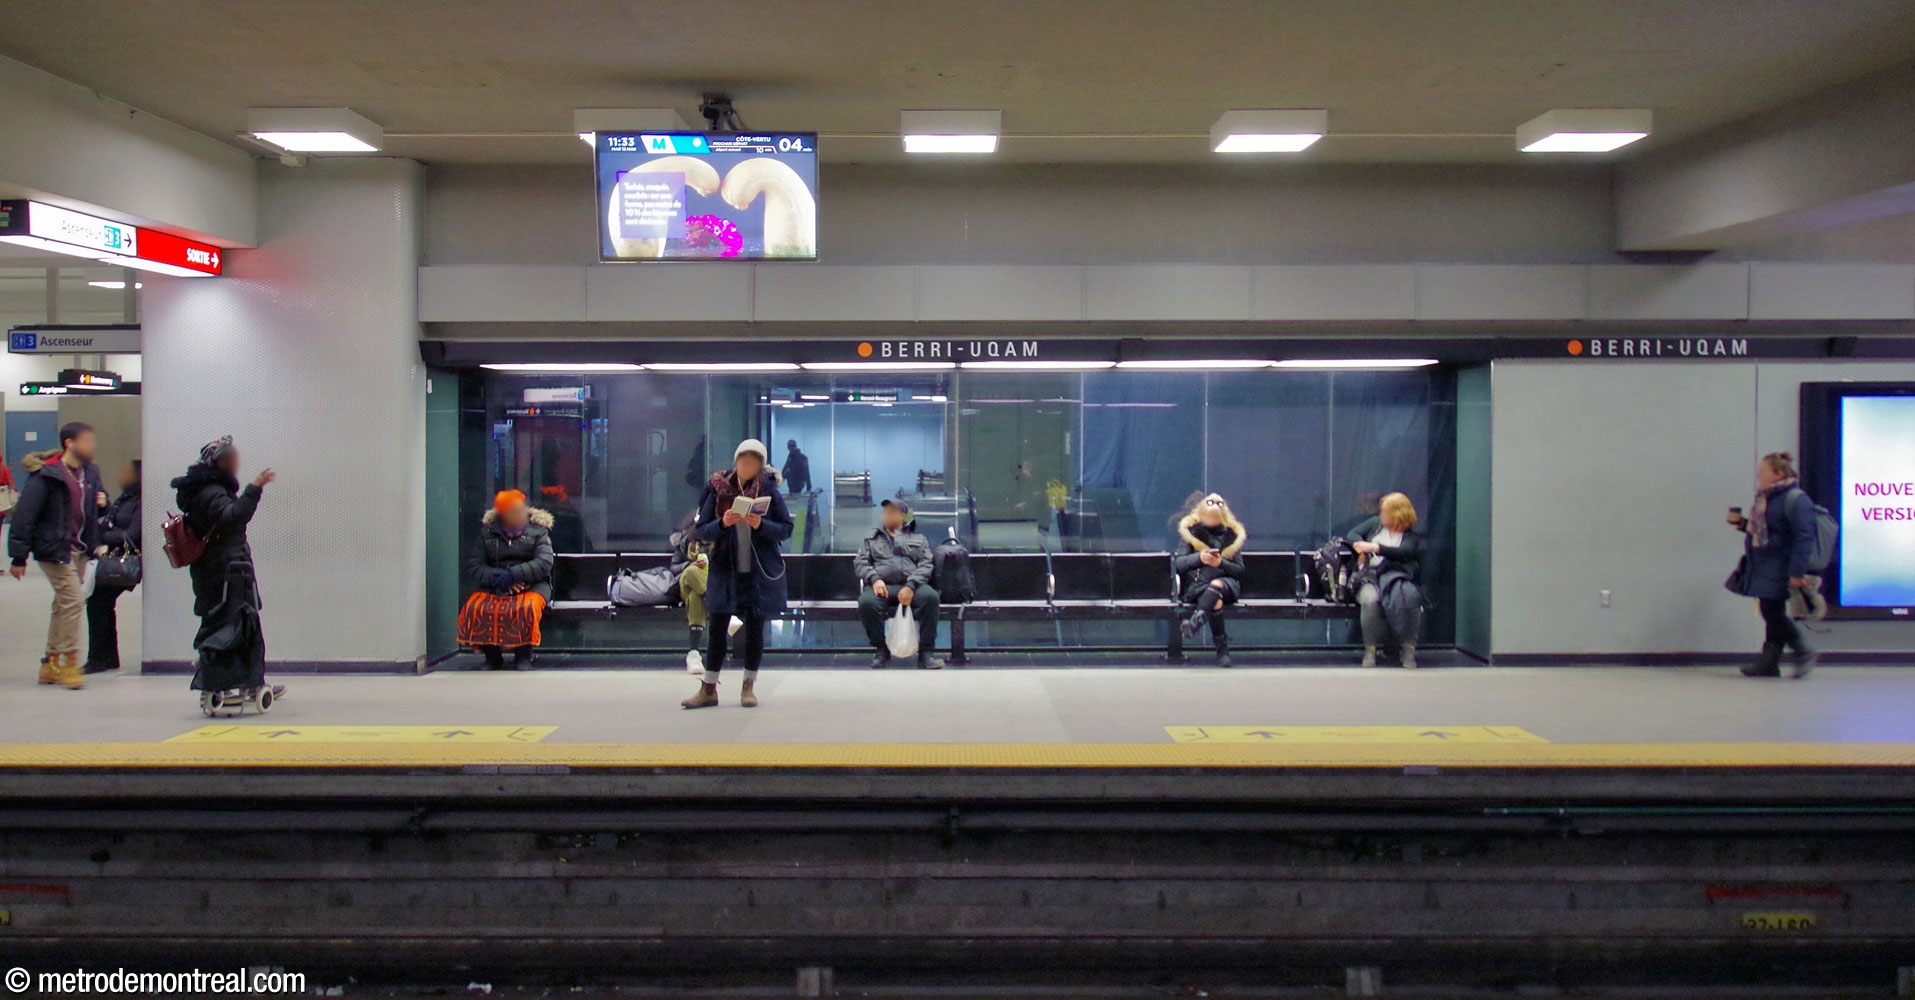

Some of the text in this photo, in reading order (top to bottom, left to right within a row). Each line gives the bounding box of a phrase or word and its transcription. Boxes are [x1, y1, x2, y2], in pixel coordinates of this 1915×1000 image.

[608, 137, 666, 150] 11:33 M
[735, 135, 772, 143] CÔTE-VERTU
[778, 137, 803, 152] 04
[186, 247, 211, 266] SORTIE
[27, 335, 94, 347] 3 Ascenseur
[1590, 339, 1749, 356] BERRI-UQAM
[881, 341, 1039, 358] BERRI-UQAM
[1854, 482, 1914, 496] NOUVE
[1861, 507, 1915, 521] VERSI
